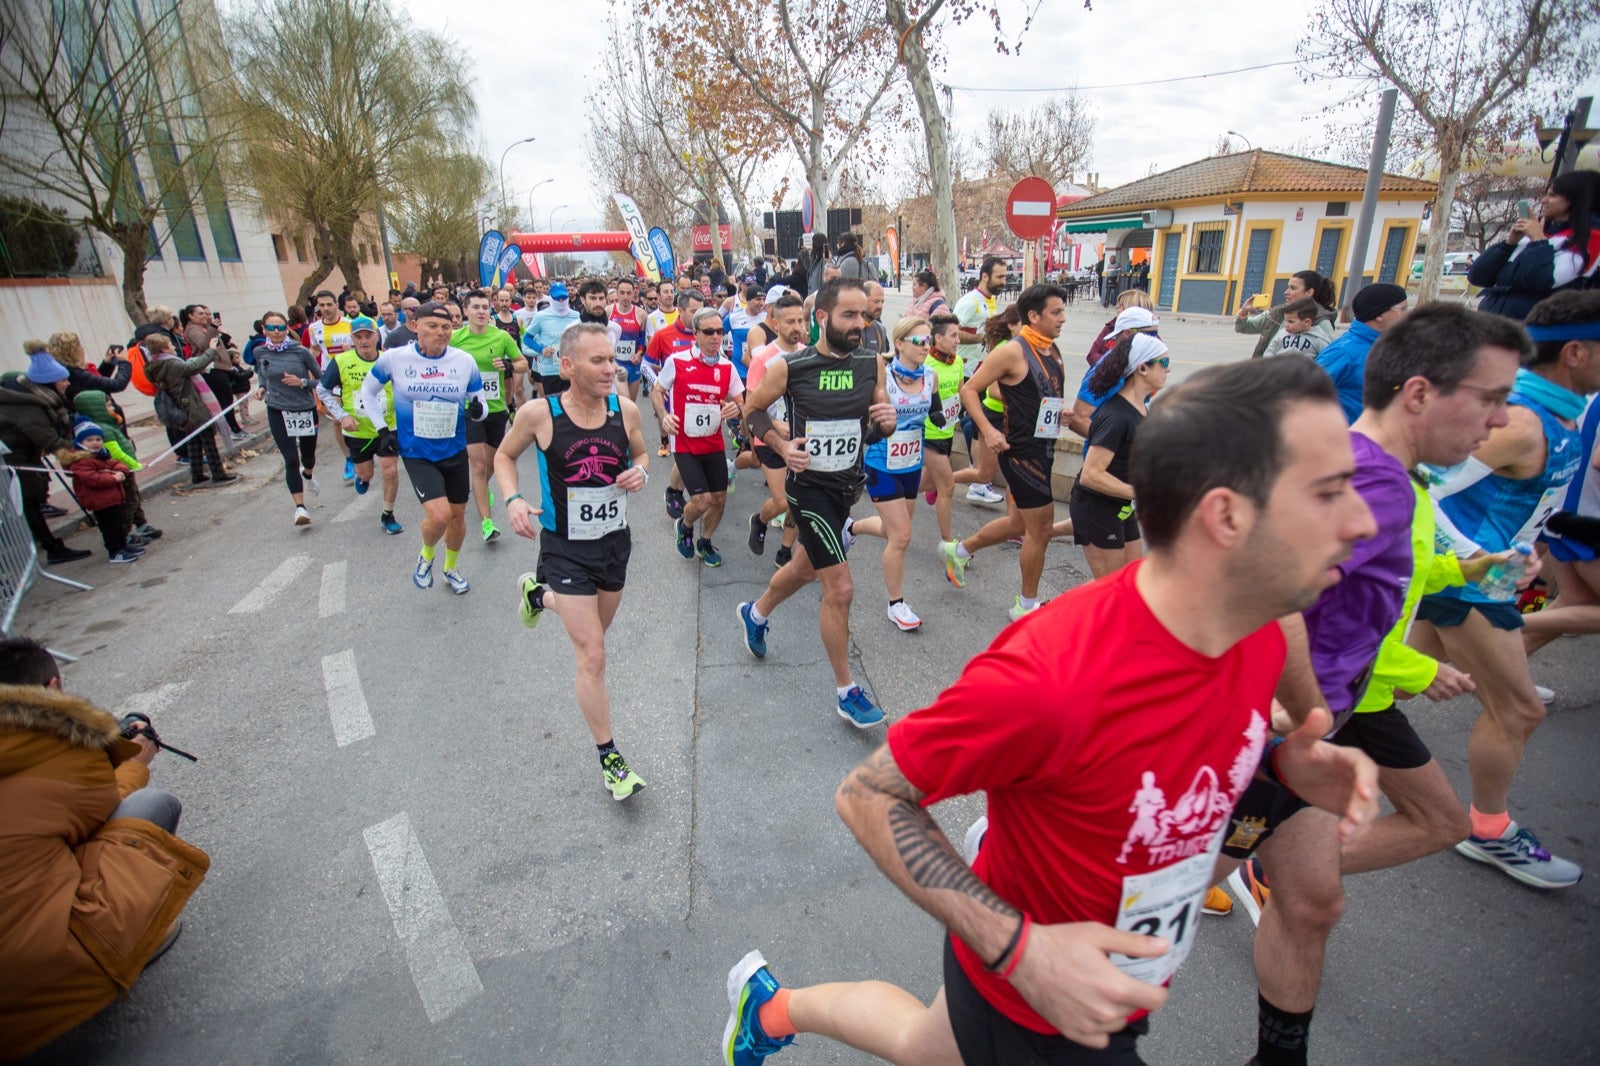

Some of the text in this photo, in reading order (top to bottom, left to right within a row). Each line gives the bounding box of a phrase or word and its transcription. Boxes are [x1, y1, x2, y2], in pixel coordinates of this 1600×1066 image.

[617, 346, 632, 354] 820
[1282, 335, 1311, 351] GAP
[407, 385, 459, 393] MARACENA
[819, 375, 853, 390] RUN
[944, 403, 960, 419] 087
[286, 419, 312, 429] 3129
[696, 415, 711, 427] 61
[809, 437, 857, 456] 3126
[891, 440, 921, 457] 2072
[580, 499, 618, 522] 845
